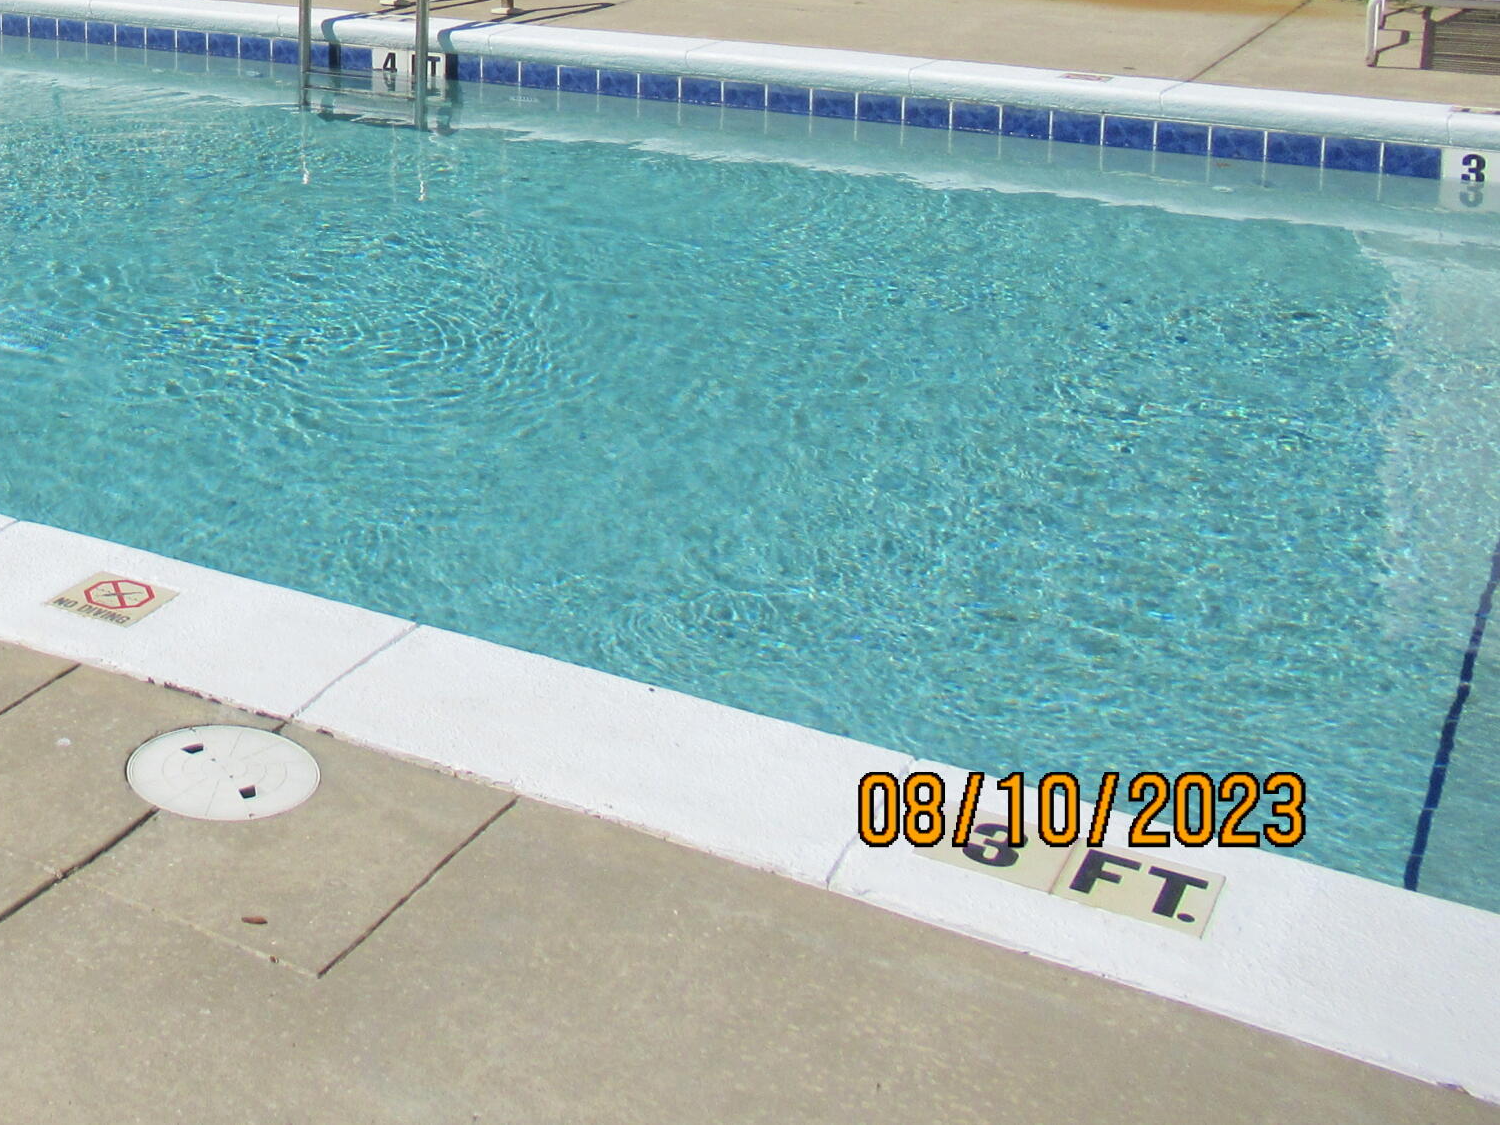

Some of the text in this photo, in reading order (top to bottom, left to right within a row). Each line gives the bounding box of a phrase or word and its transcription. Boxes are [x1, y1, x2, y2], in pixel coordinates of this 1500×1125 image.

[383, 52, 397, 73] 4
[1461, 154, 1486, 182] 3
[53, 597, 130, 624] NO DIVING
[962, 823, 1209, 923] 3 FT.
